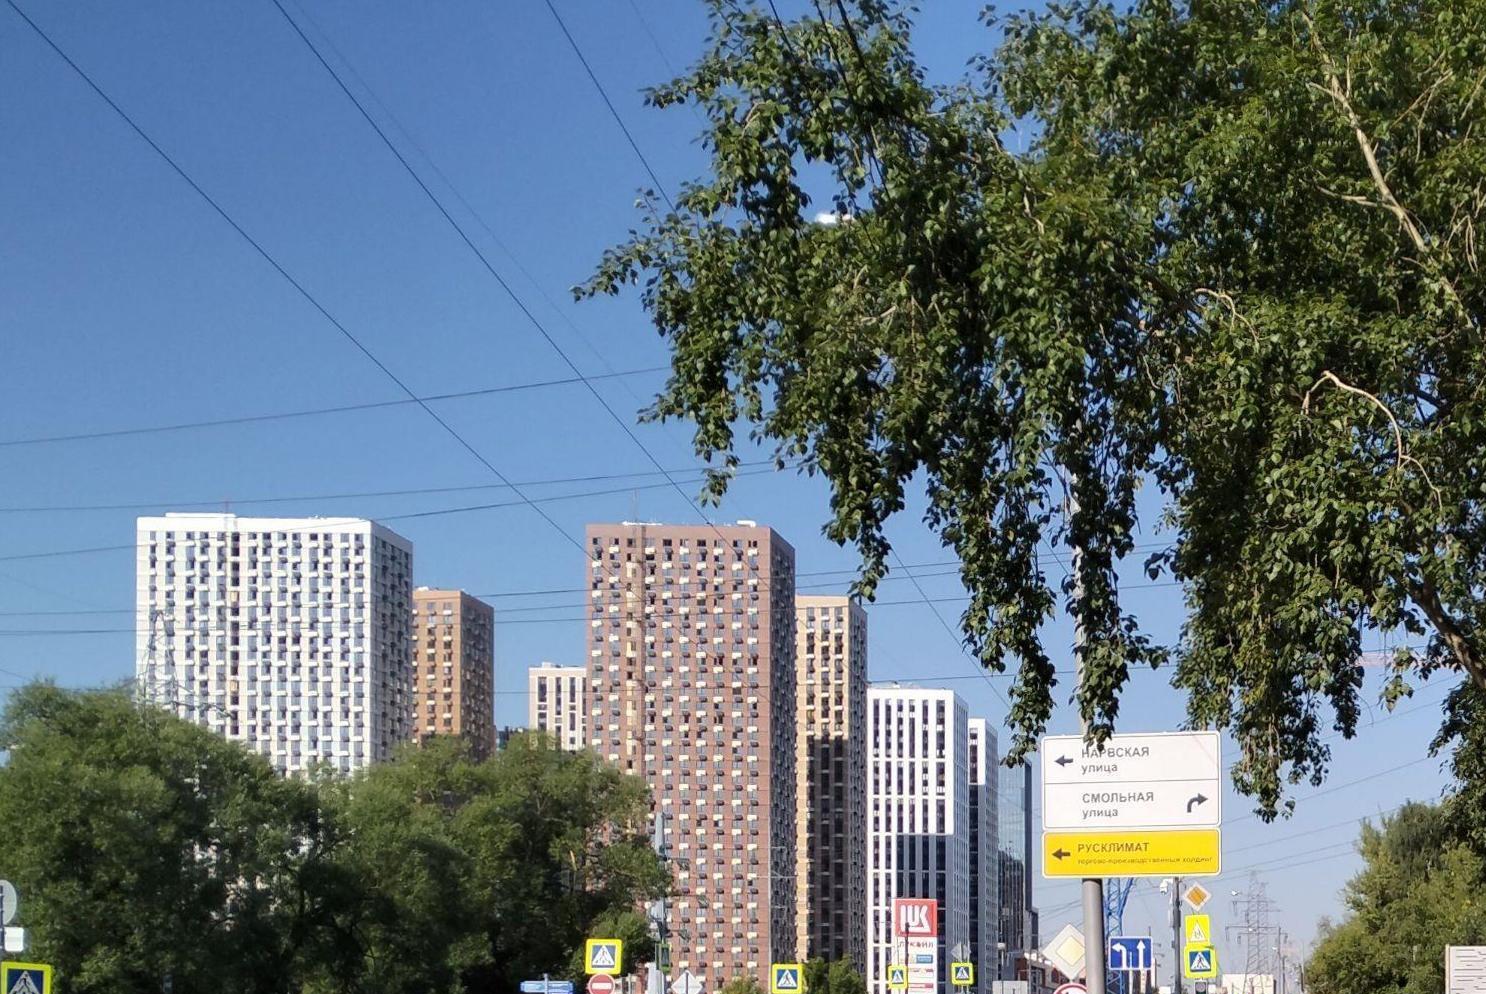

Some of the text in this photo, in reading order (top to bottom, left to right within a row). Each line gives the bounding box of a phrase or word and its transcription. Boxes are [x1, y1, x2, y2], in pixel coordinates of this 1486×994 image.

[1081, 764, 1118, 775] улица
[1082, 791, 1154, 803] СМОЛЬНАЯ
[1082, 808, 1119, 820] улица
[1077, 842, 1150, 853] РУСКЛИМАТ
